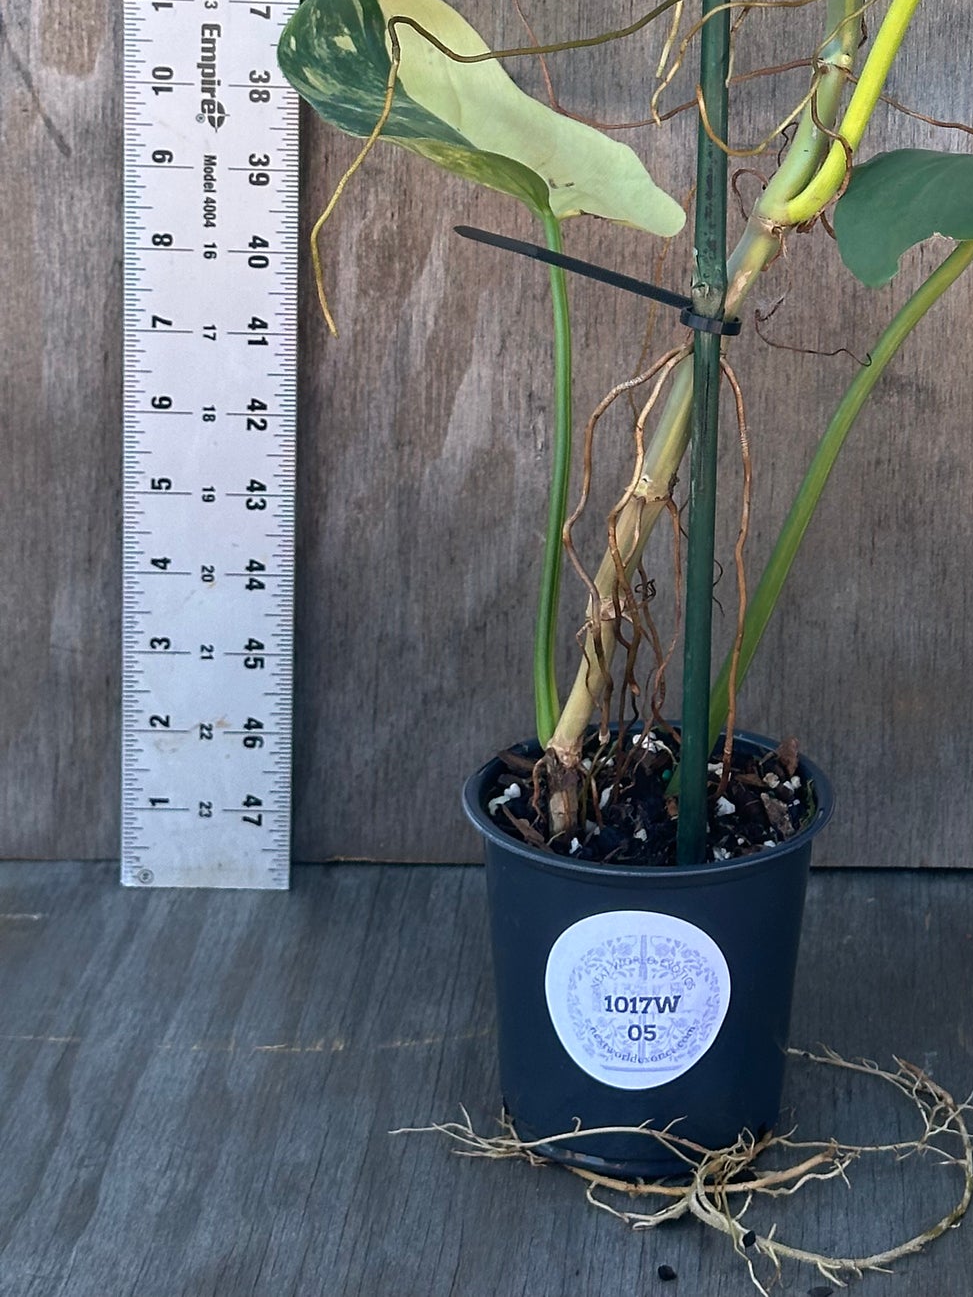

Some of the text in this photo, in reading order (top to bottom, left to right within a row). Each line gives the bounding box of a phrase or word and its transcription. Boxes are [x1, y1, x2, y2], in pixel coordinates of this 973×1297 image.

[196, 23, 222, 114] Empire
[151, 66, 174, 96] 10
[248, 69, 272, 104] 38
[151, 149, 174, 164] 9
[248, 153, 271, 187] 39
[202, 154, 218, 229] Model 4004
[151, 233, 174, 248] 8
[202, 241, 218, 260] 16
[247, 234, 270, 269] 40
[150, 314, 173, 329] 7
[247, 316, 269, 346] 41
[202, 323, 218, 342] 17
[150, 395, 173, 410] 6
[201, 404, 217, 423] 18
[246, 397, 269, 432] 42
[150, 477, 172, 491] 5
[201, 485, 217, 503] 19
[245, 478, 267, 511] 43
[150, 556, 172, 571] 4
[200, 564, 216, 583] 20
[244, 558, 267, 592] 44
[149, 637, 172, 651] 3
[199, 644, 215, 661] 21
[243, 637, 265, 670] 45
[148, 714, 171, 729] 2
[198, 722, 214, 741] 22
[242, 717, 265, 749] 46
[148, 796, 170, 807] 1
[198, 801, 213, 819] 23
[241, 794, 264, 827] 47
[603, 994, 682, 1015] 1017W
[627, 1023, 657, 1042] 05
